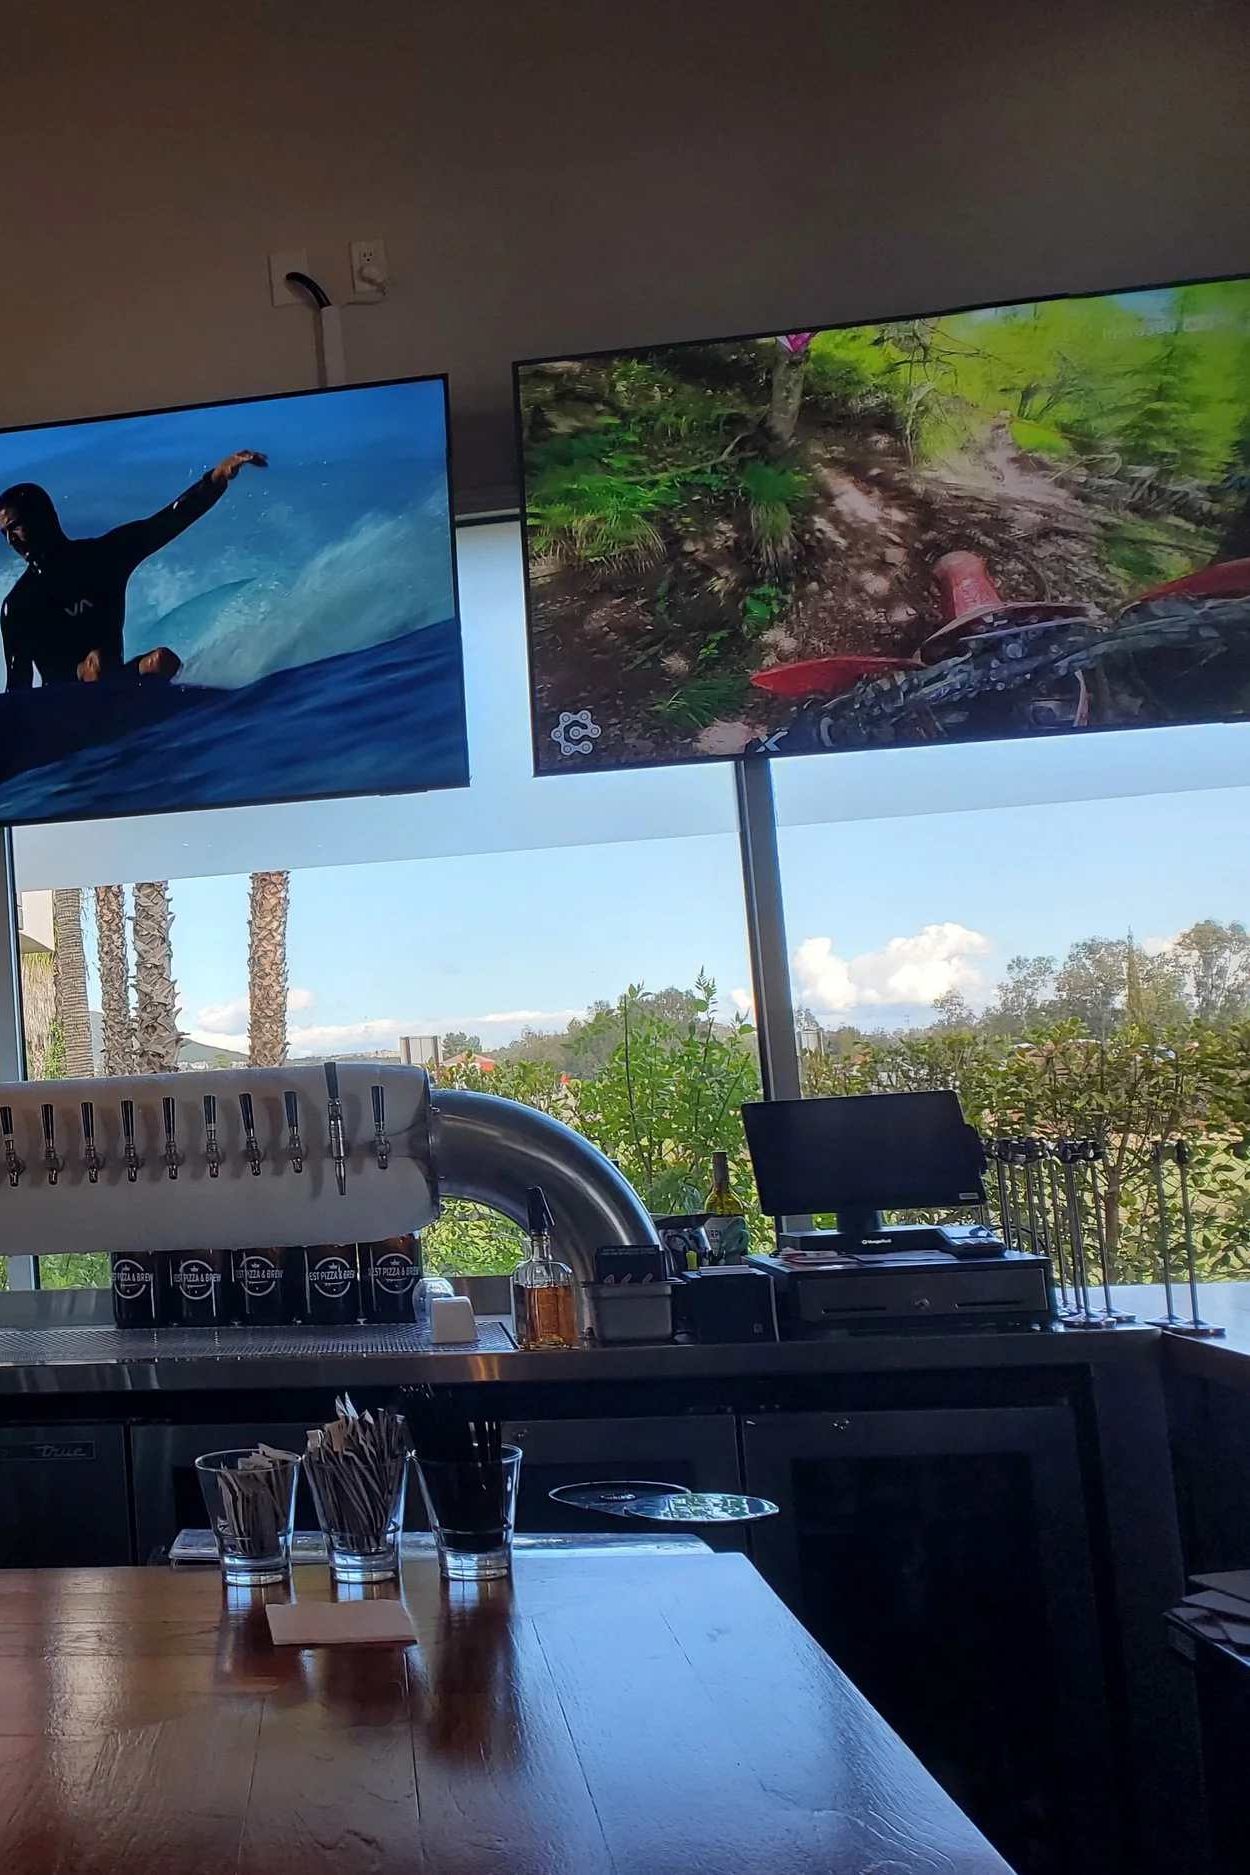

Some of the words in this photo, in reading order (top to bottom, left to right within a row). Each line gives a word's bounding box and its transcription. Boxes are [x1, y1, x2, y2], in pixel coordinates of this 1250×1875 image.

[320, 1270, 338, 1280] PIZZA
[382, 1266, 400, 1277] PIZZA
[33, 1444, 87, 1457] True
